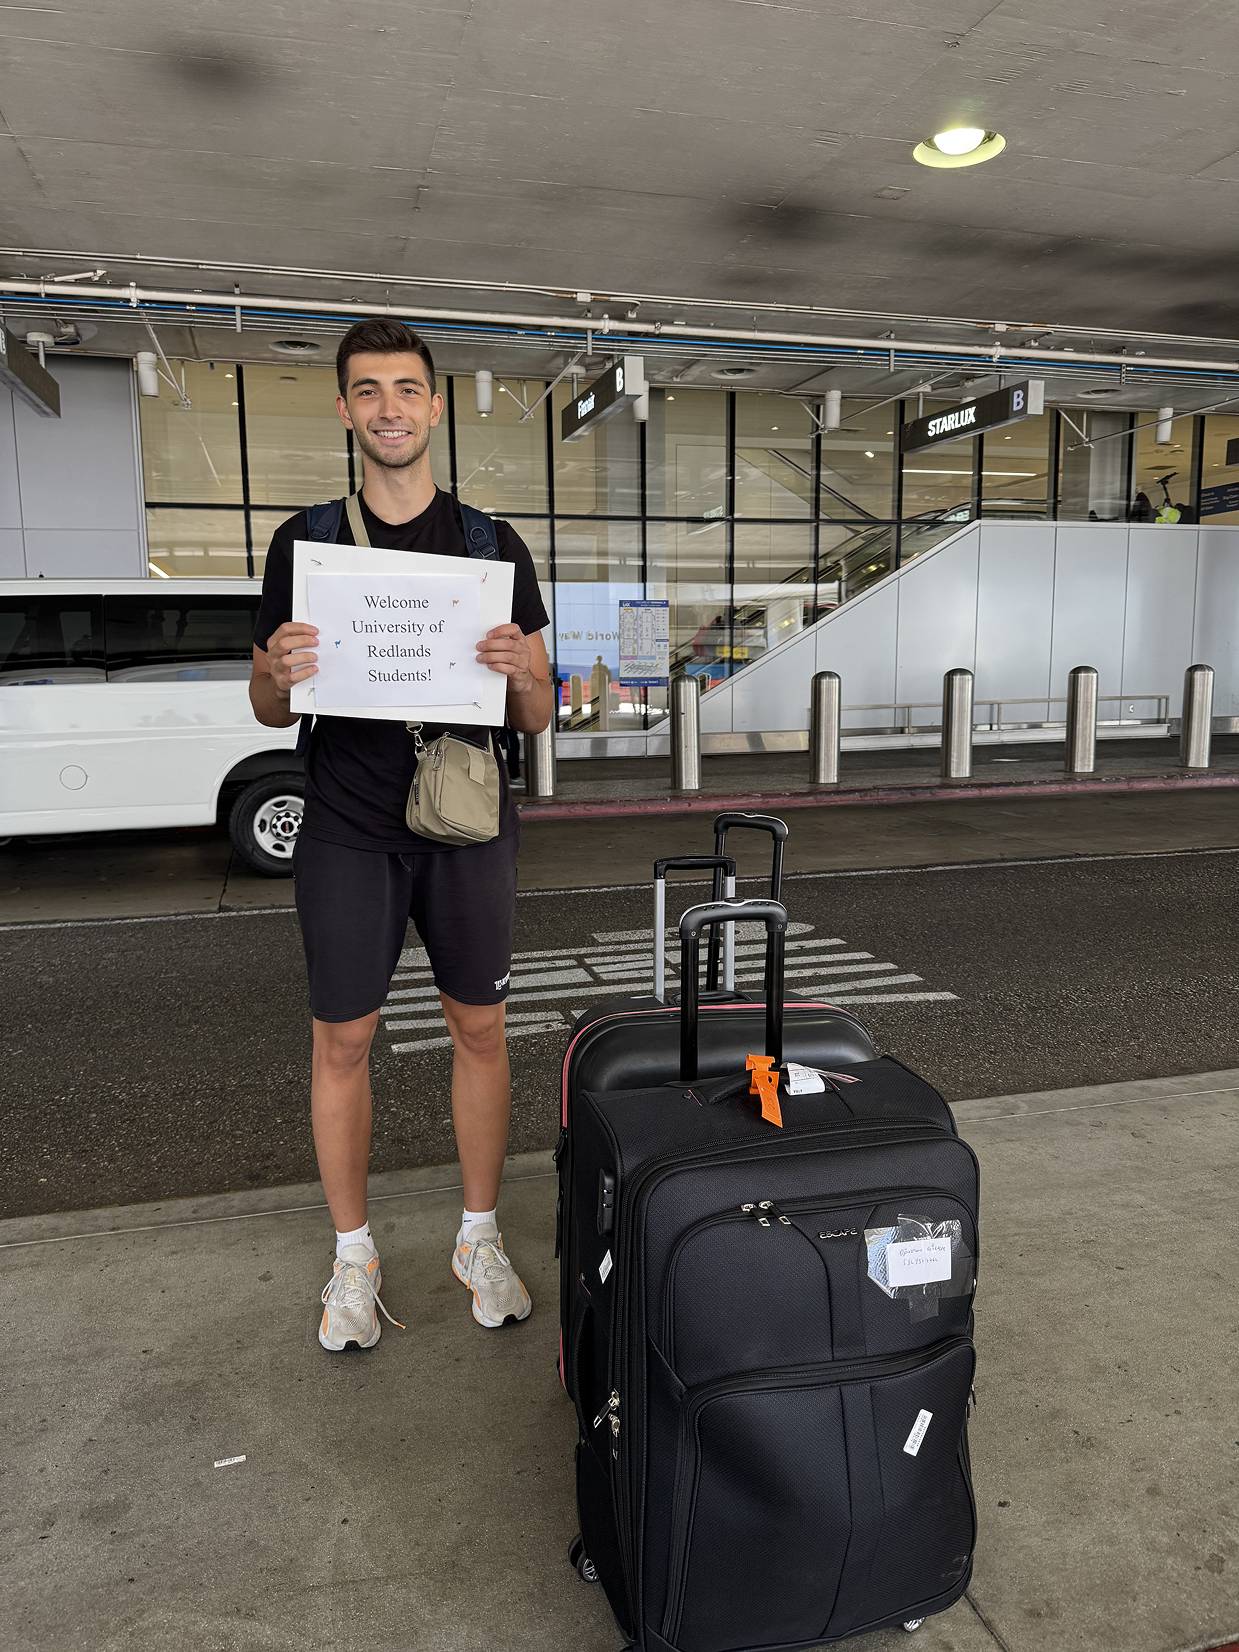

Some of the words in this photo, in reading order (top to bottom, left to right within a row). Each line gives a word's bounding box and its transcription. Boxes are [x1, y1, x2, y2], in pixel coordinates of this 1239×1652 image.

[615, 366, 624, 393] B
[927, 405, 977, 437] STARLUX
[1012, 389, 1025, 412] B
[364, 595, 430, 609] Welcome
[352, 620, 425, 637] University
[429, 619, 445, 633] of
[367, 644, 431, 658] Redlands
[368, 669, 432, 682] Students!
